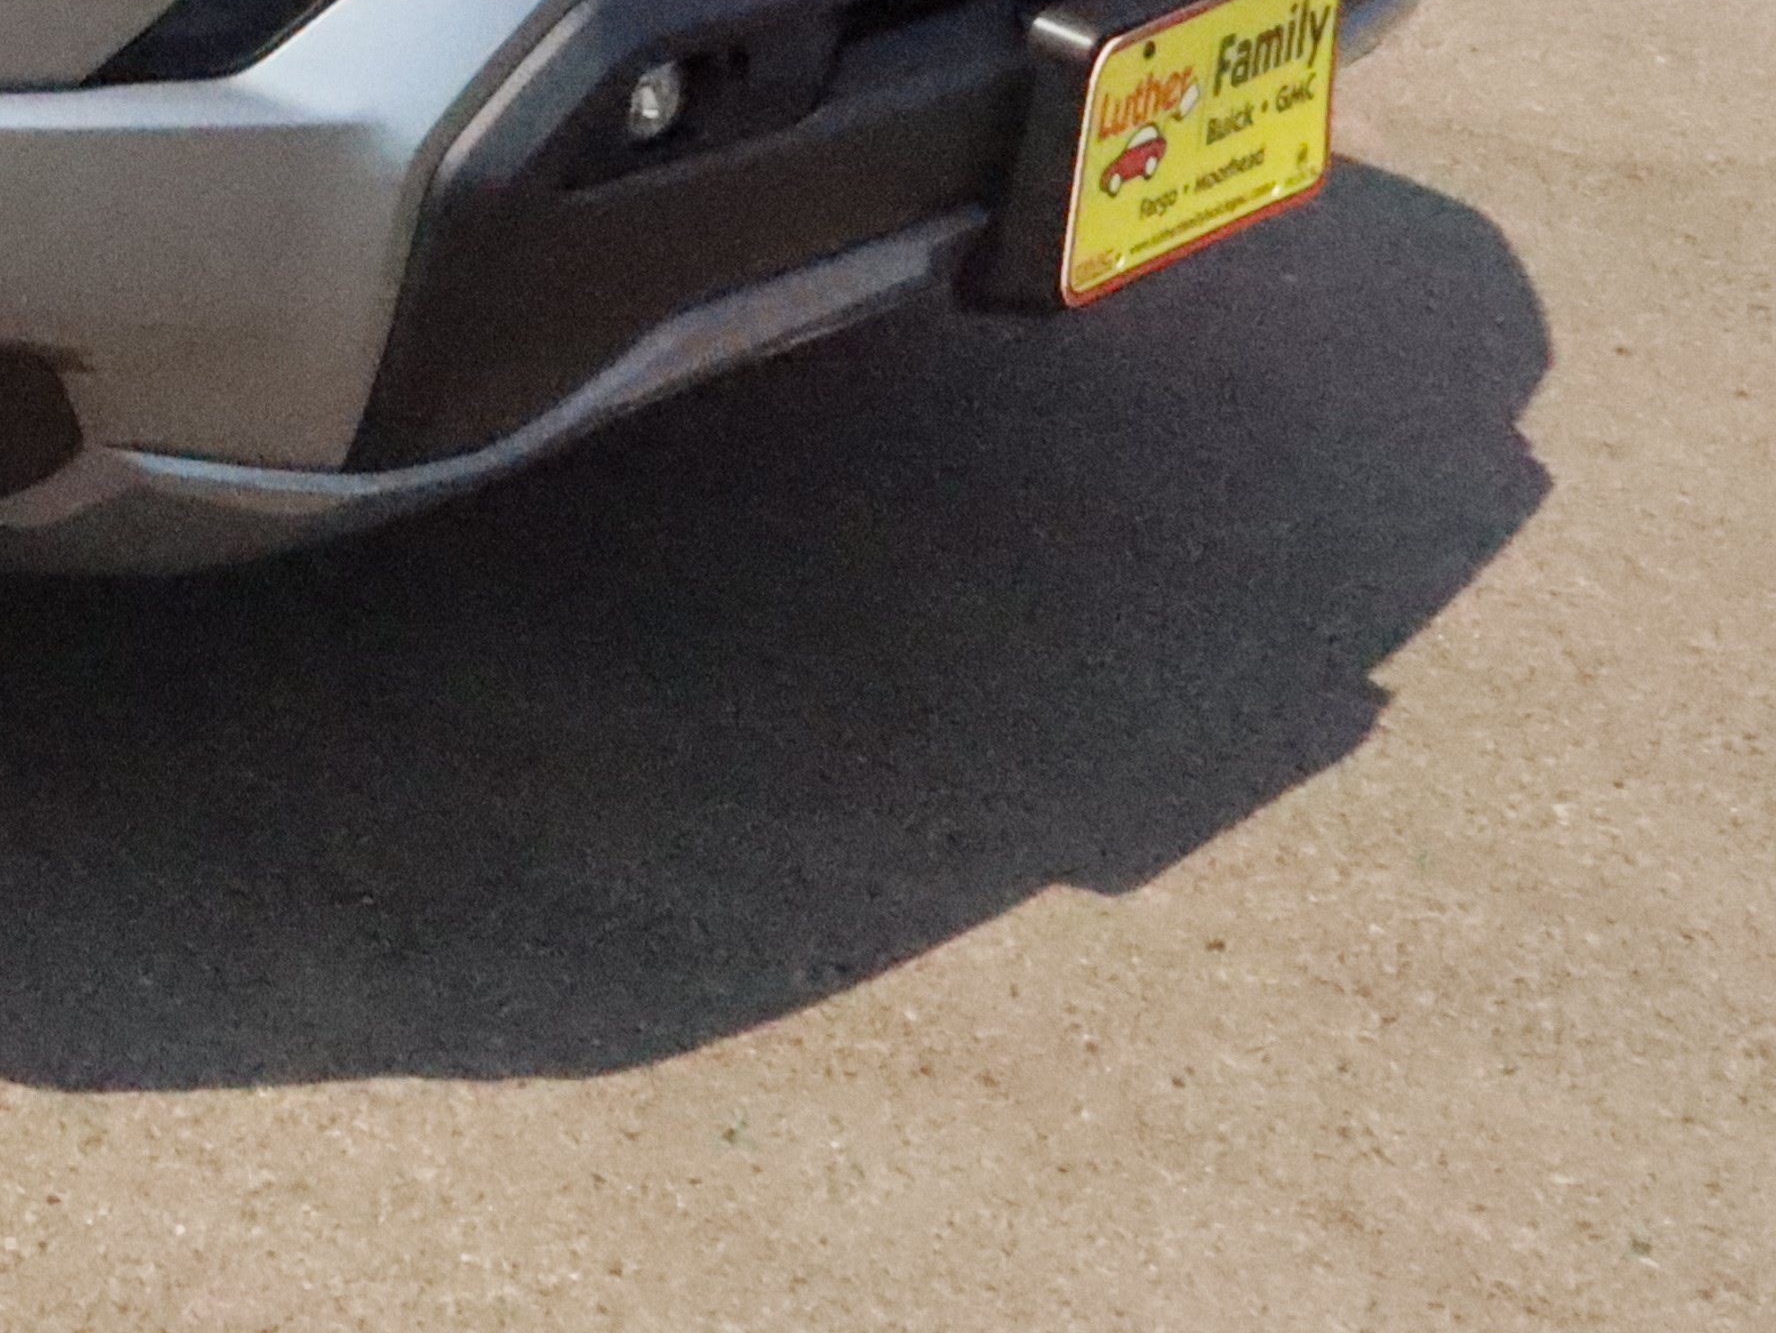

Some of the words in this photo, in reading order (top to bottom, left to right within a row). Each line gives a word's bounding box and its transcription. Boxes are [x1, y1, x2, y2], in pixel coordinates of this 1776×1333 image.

[1213, 0, 1330, 97] Family
[1098, 65, 1194, 143] Luther
[1206, 102, 1254, 146] Buick
[1275, 72, 1316, 113] GMC
